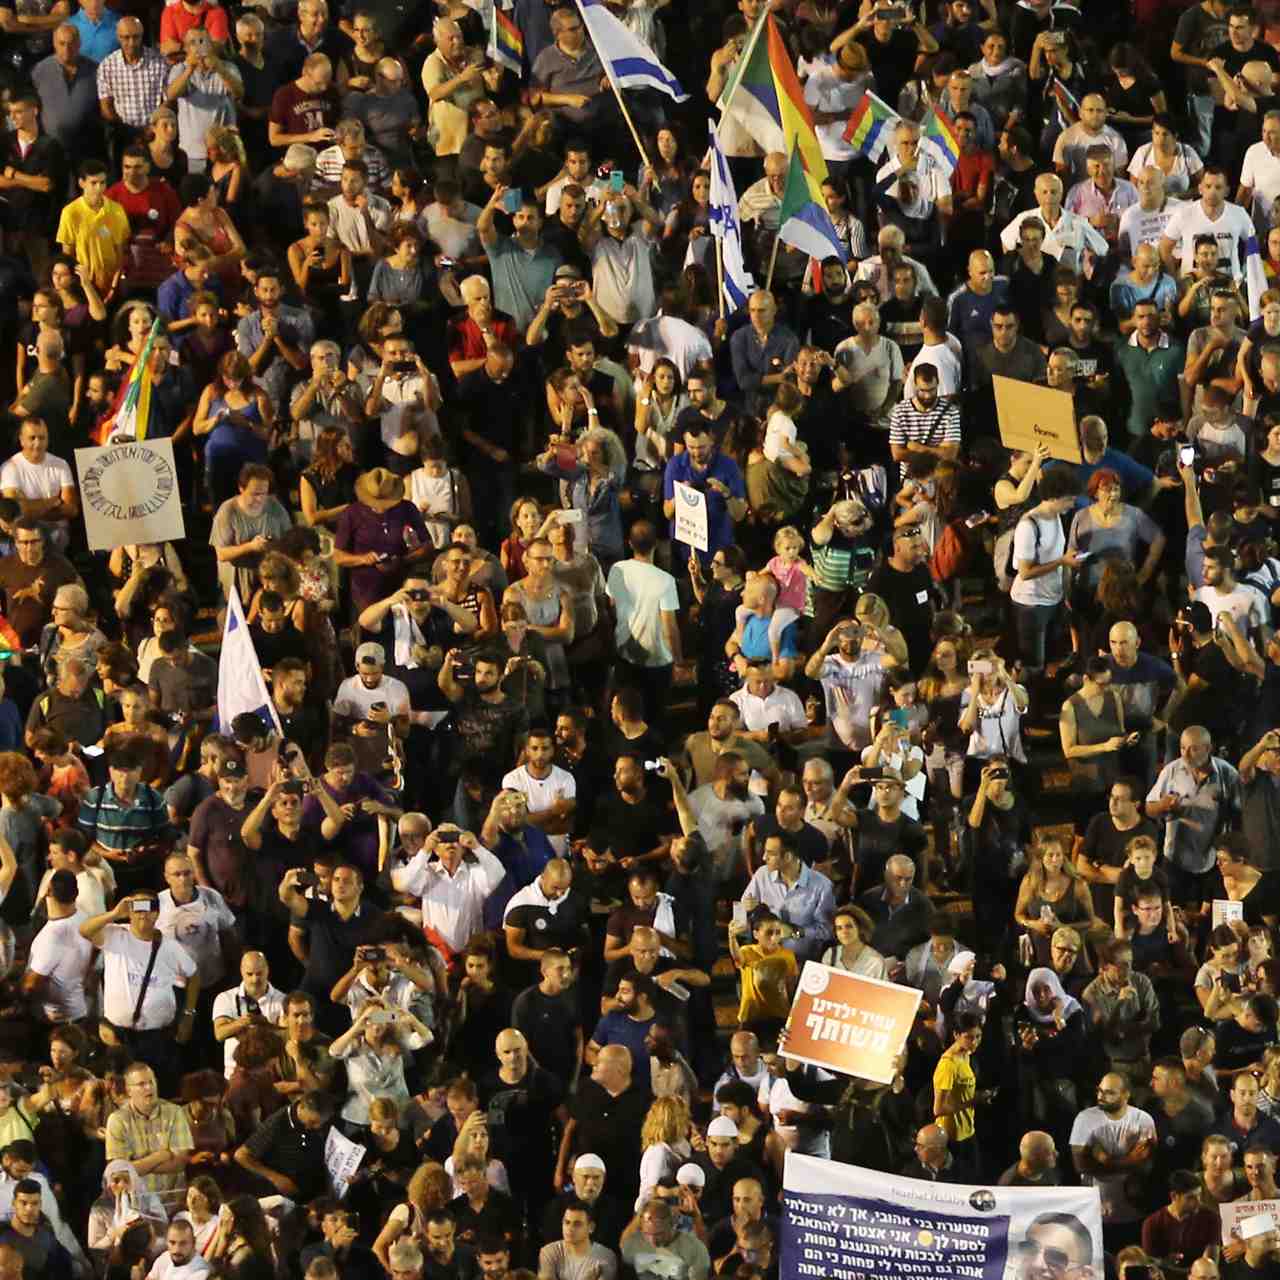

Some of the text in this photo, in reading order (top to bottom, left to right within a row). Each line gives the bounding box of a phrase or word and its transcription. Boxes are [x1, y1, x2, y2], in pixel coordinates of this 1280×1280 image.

[811, 997, 857, 1019] ילדינו
[805, 1013, 891, 1049] משותף
[783, 1198, 990, 1237] מצטערת בני אהובי, אך לא יכולתי
[788, 1212, 840, 1233] להתאבל
[842, 1224, 886, 1239] אצטרך
[890, 1229, 911, 1243] אני
[840, 1239, 902, 1258] ולהתגעגע
[951, 1238, 987, 1251] לספר
[804, 1248, 984, 1279] אתה גם תחסר לי פחות כי הם
[904, 1249, 944, 1262] לבכות
[798, 1262, 826, 1276] אתה
